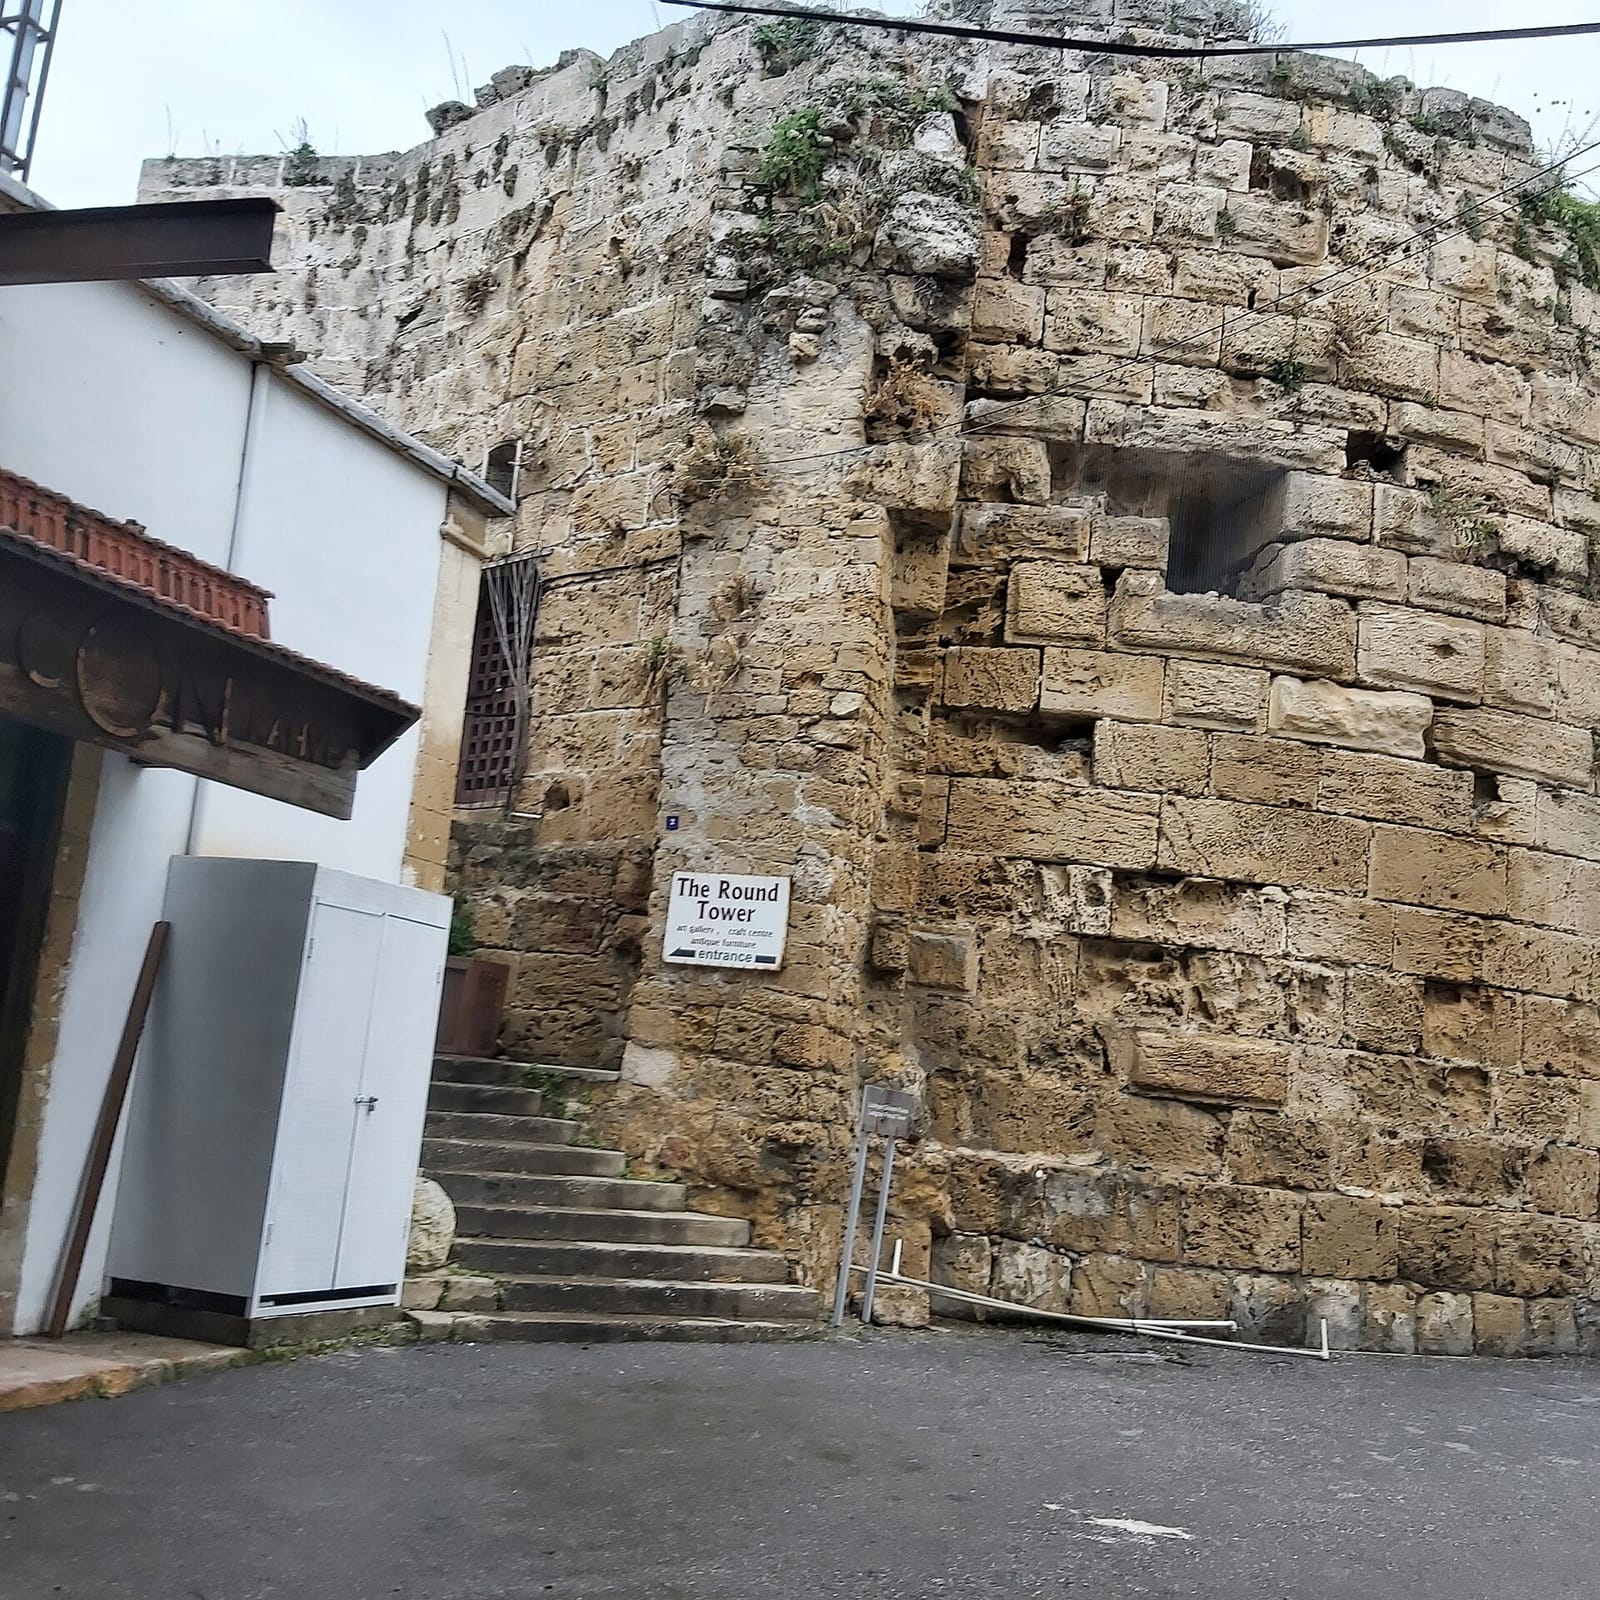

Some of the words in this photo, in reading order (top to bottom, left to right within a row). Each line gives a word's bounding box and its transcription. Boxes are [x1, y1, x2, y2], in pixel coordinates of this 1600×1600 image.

[677, 877, 710, 897] The
[718, 880, 779, 902] Round
[697, 900, 756, 922] Tower
[728, 928, 746, 936] craft
[690, 937, 720, 947] antique
[722, 938, 757, 949] furniture
[698, 949, 752, 963] entrance
